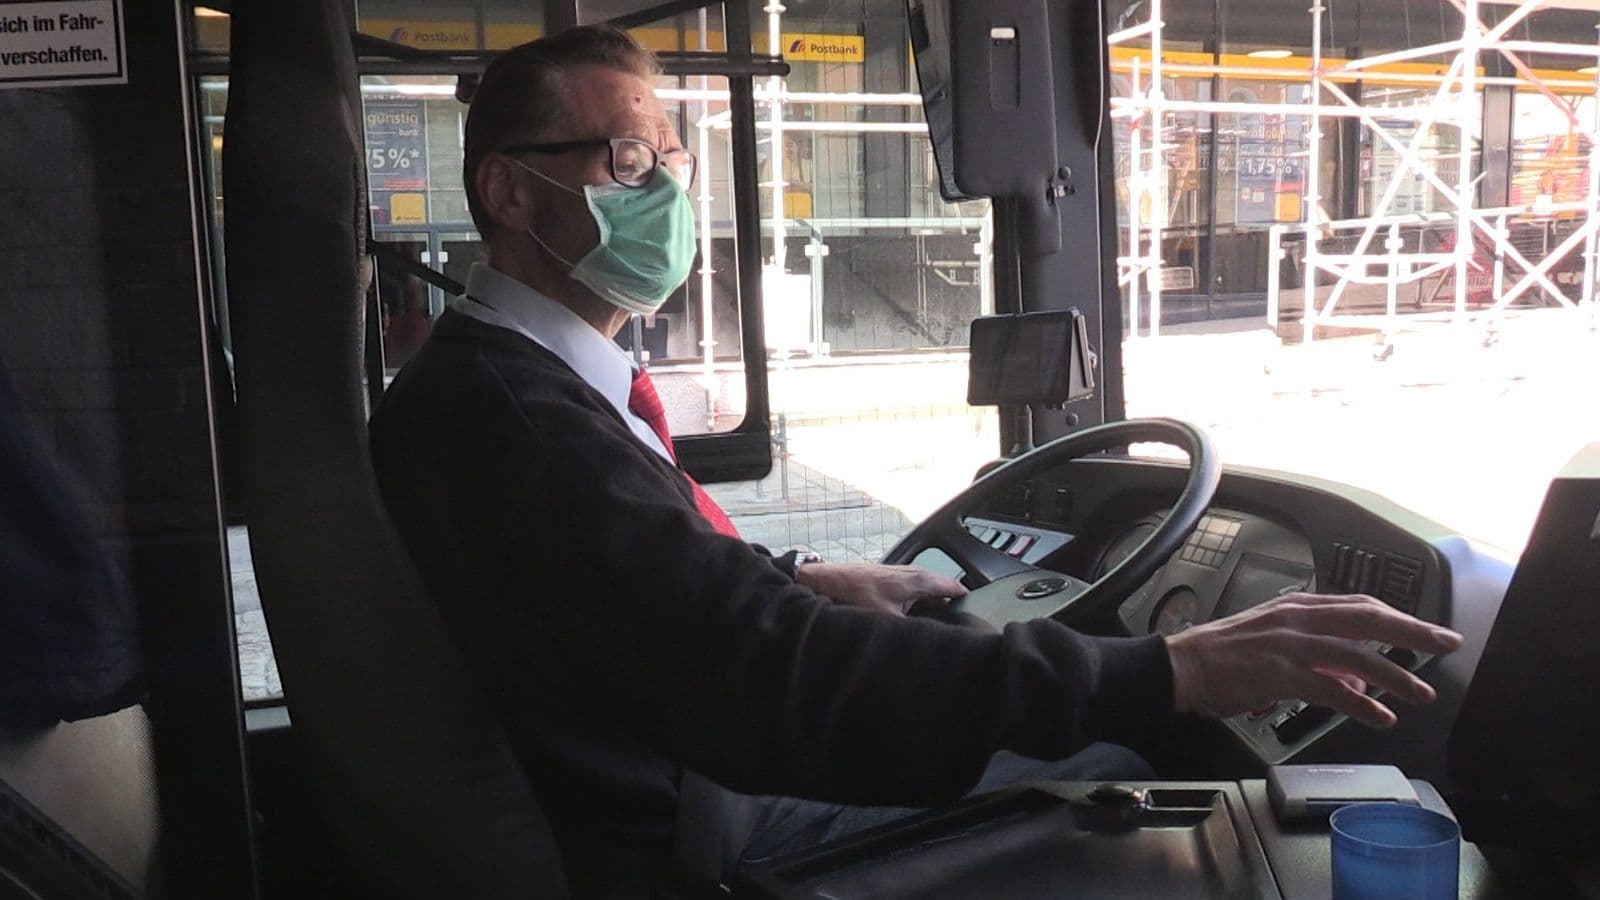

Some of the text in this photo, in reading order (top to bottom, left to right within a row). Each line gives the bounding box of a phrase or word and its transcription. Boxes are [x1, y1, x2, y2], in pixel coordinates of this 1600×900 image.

[33, 15, 55, 32] im
[59, 13, 104, 31] Fahr-
[415, 31, 470, 42] Postbank
[1, 45, 108, 65] verschaffen.
[810, 43, 858, 54] Postbank
